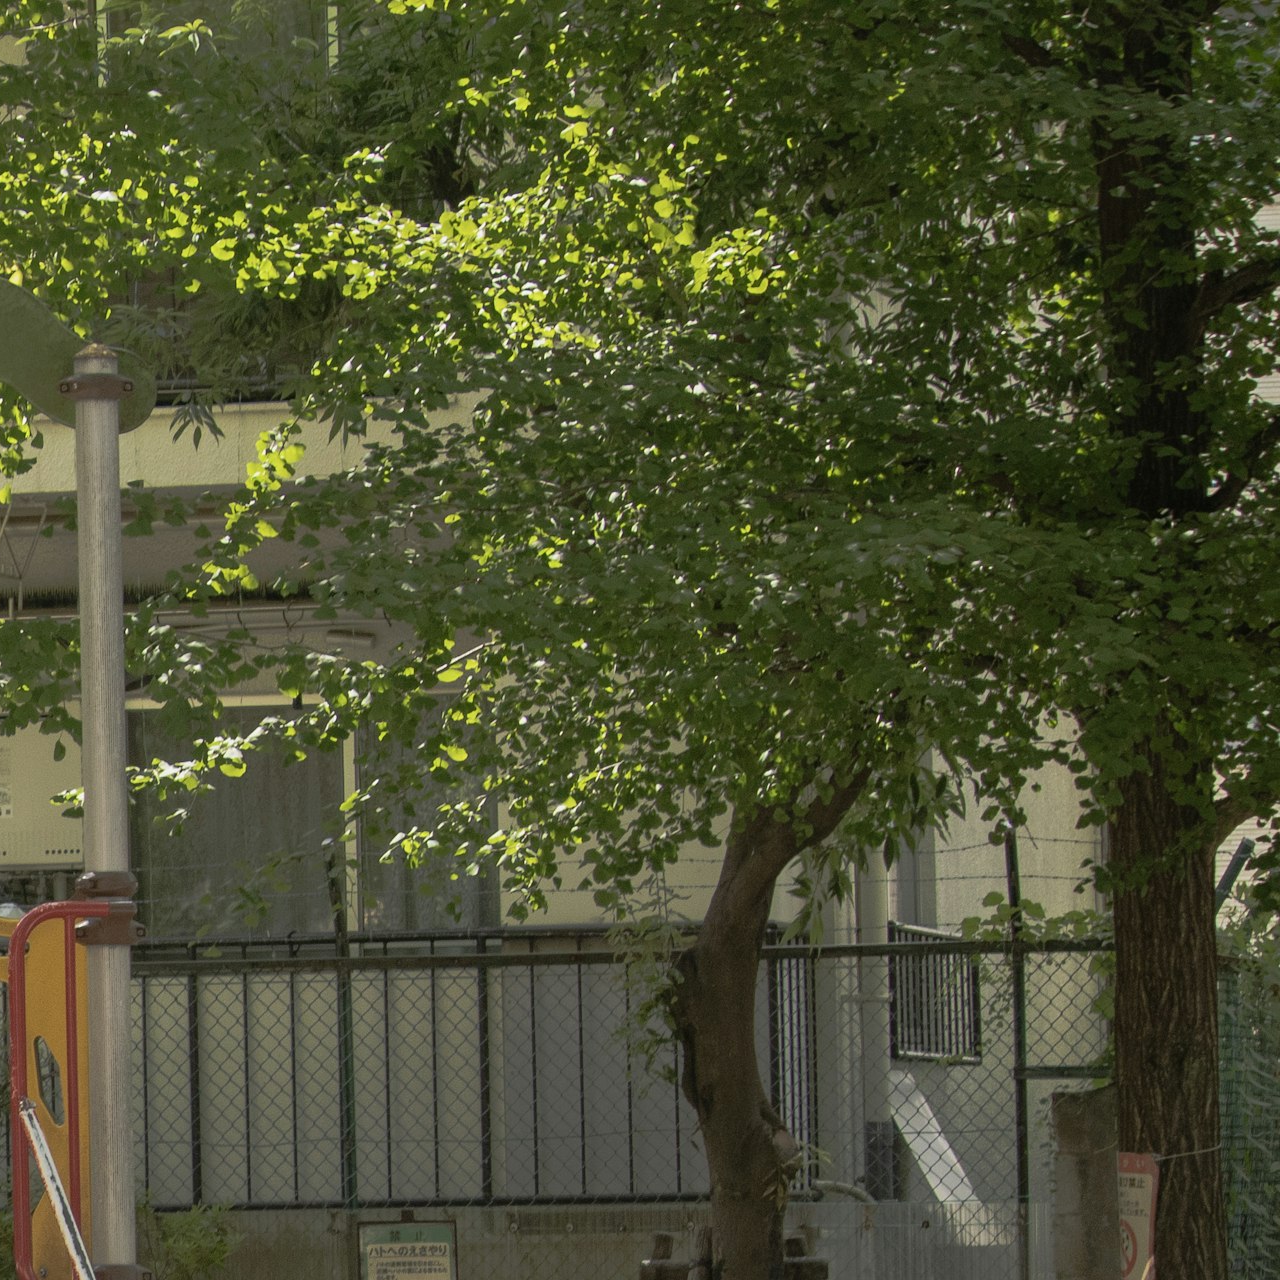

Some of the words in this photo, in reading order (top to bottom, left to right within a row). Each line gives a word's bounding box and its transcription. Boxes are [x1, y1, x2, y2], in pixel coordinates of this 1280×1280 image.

[369, 1245, 447, 1257] ハトへのえさやり
